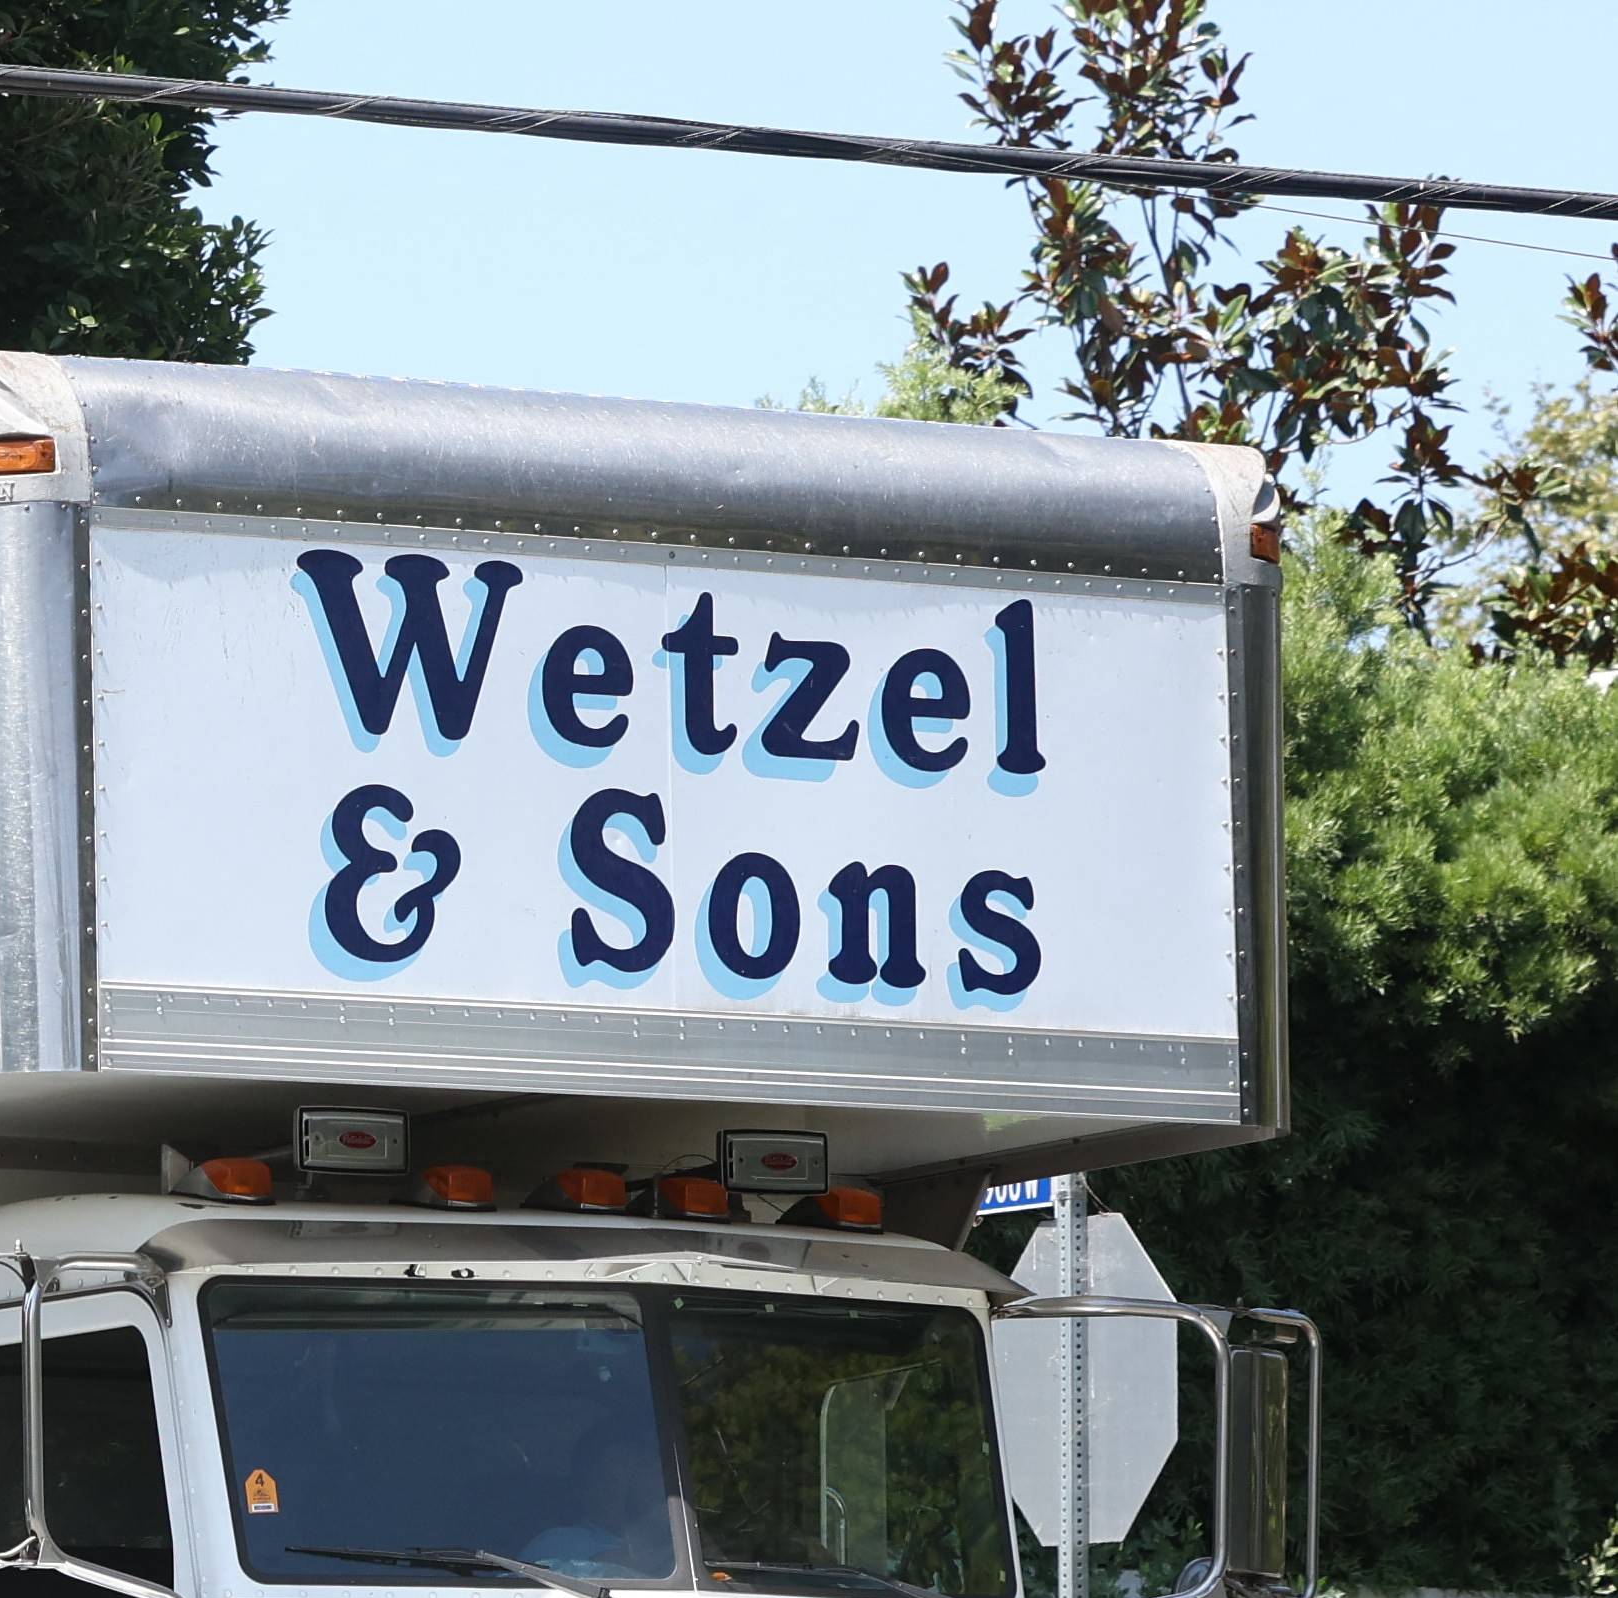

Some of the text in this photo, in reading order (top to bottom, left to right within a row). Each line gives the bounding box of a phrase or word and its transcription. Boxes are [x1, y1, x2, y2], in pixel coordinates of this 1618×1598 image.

[296, 549, 1048, 776] Wetzel
[324, 784, 1043, 997] & Sons
